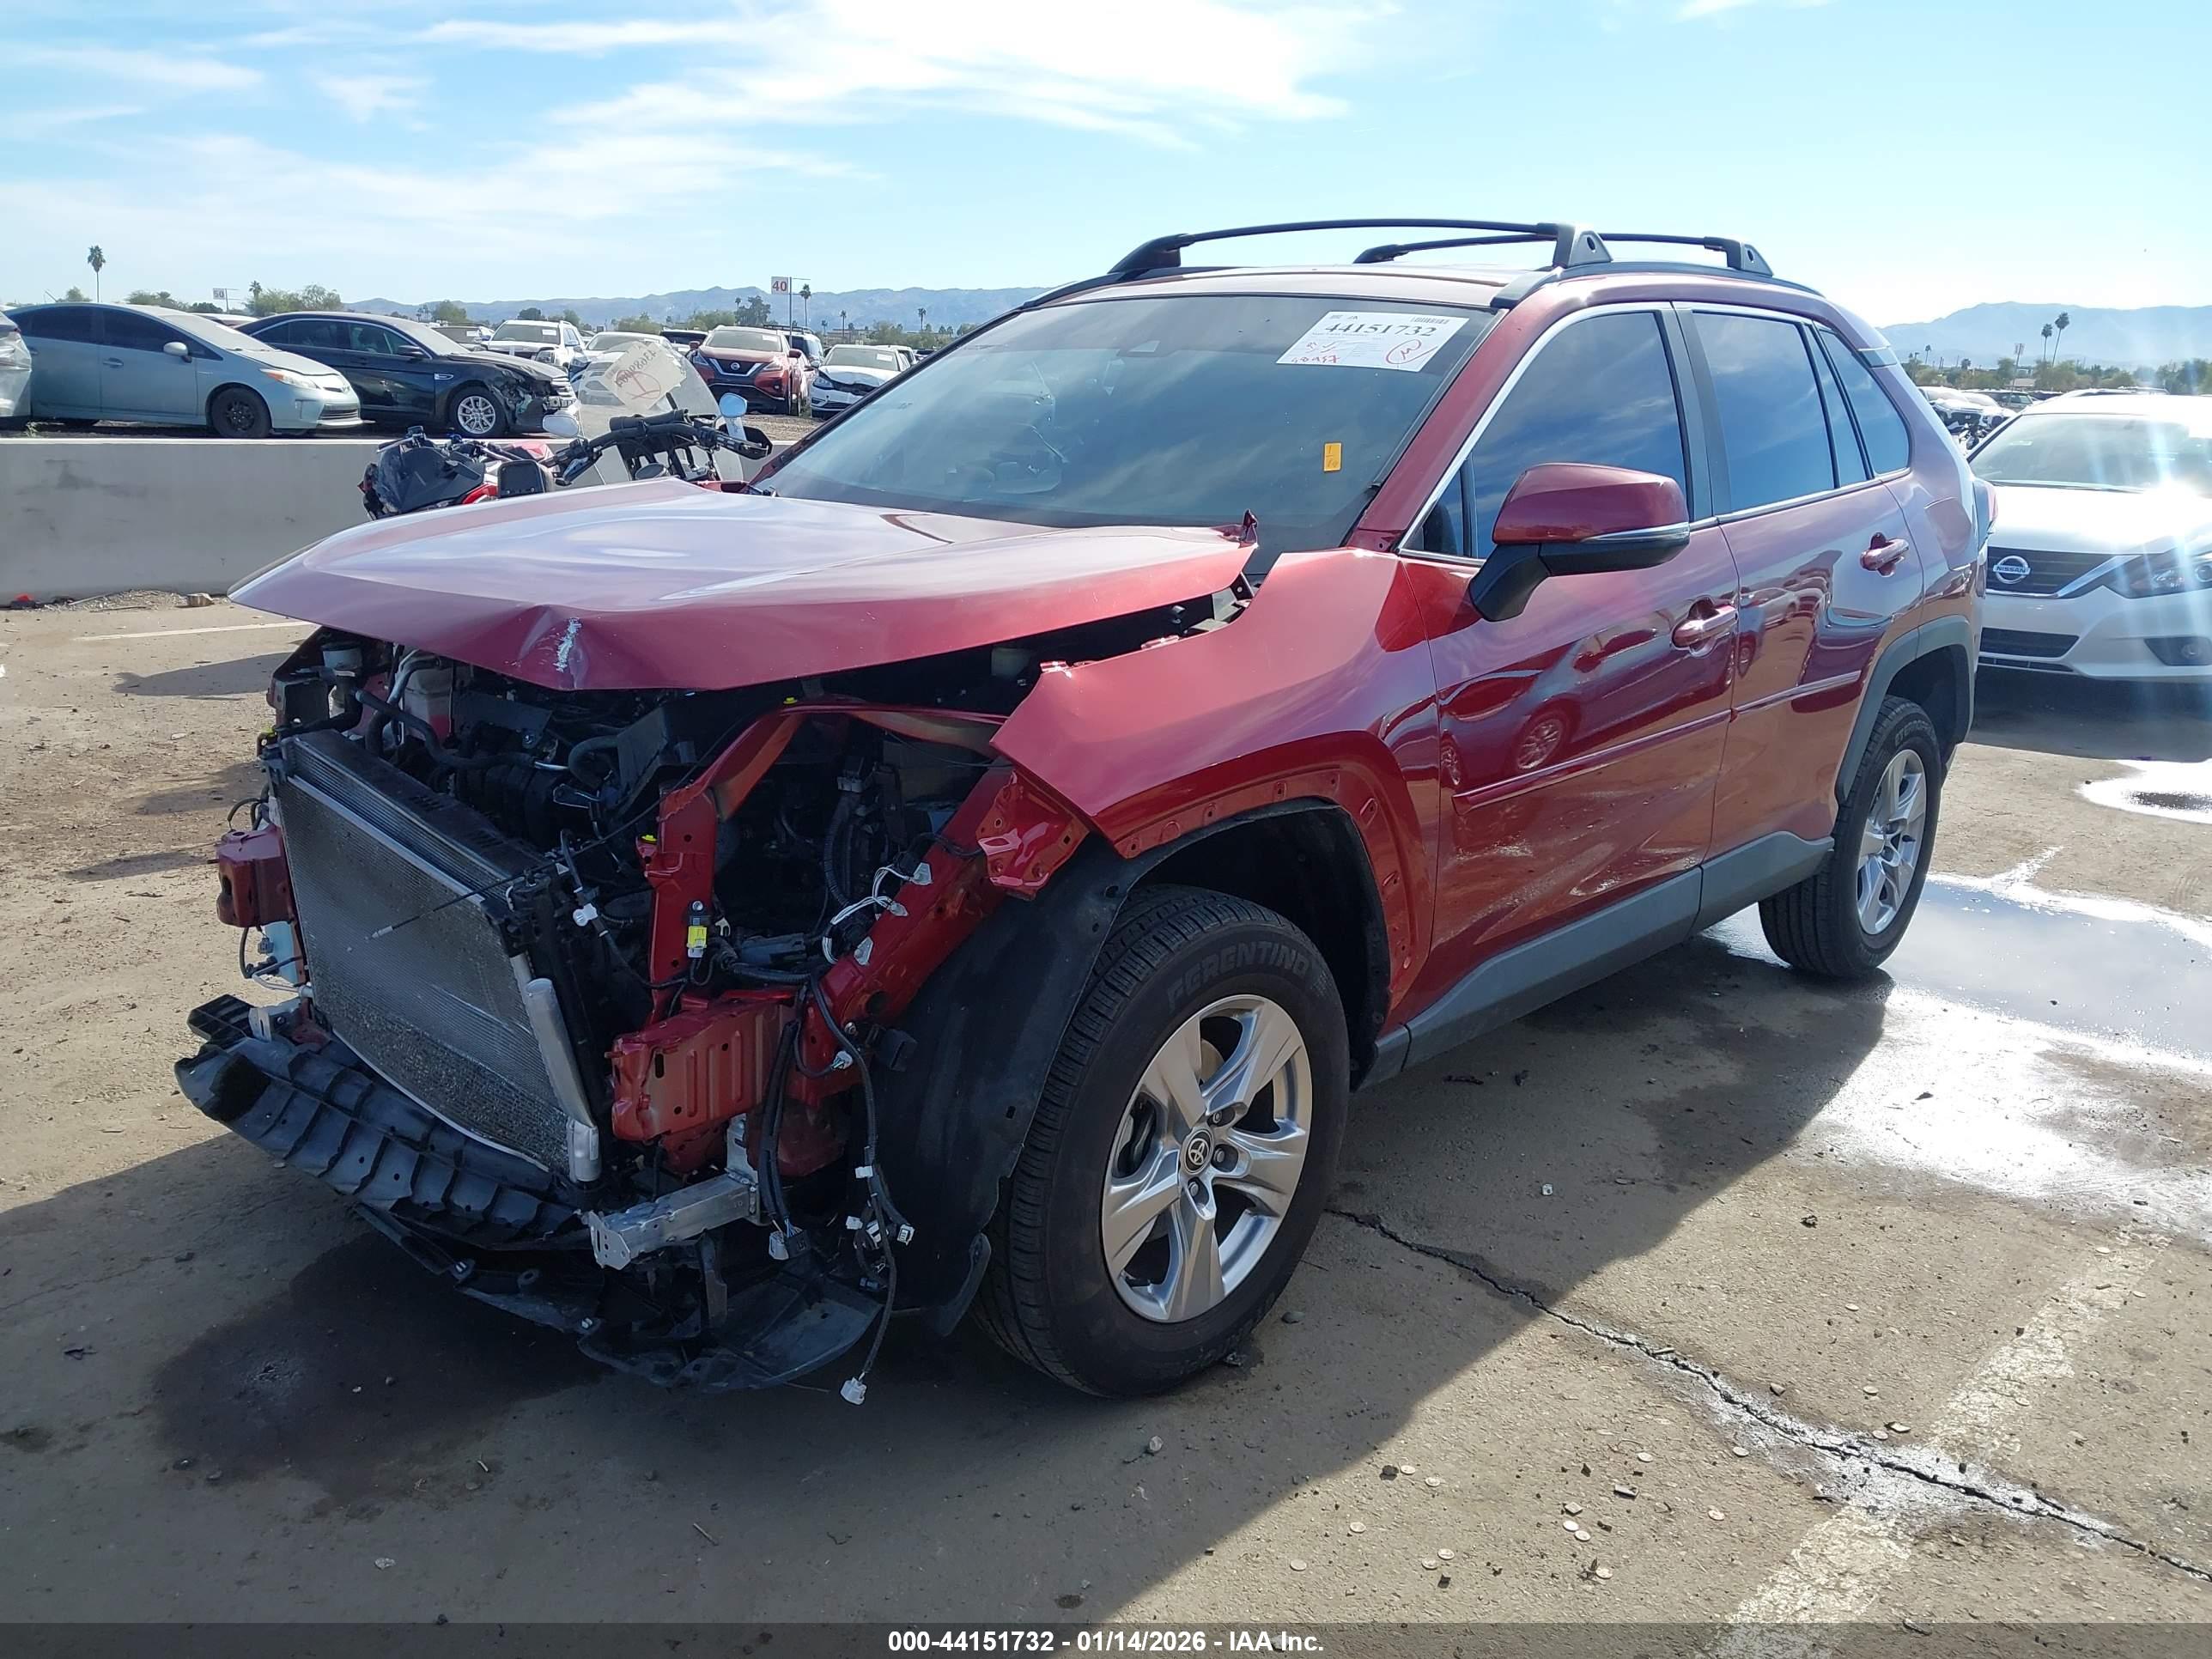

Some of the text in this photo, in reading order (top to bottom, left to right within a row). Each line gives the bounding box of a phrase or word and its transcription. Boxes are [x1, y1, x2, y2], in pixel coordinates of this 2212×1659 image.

[772, 280, 788, 292] 40
[1324, 322, 1437, 337] 44151732
[1168, 940, 1310, 1011] FERENTINO
